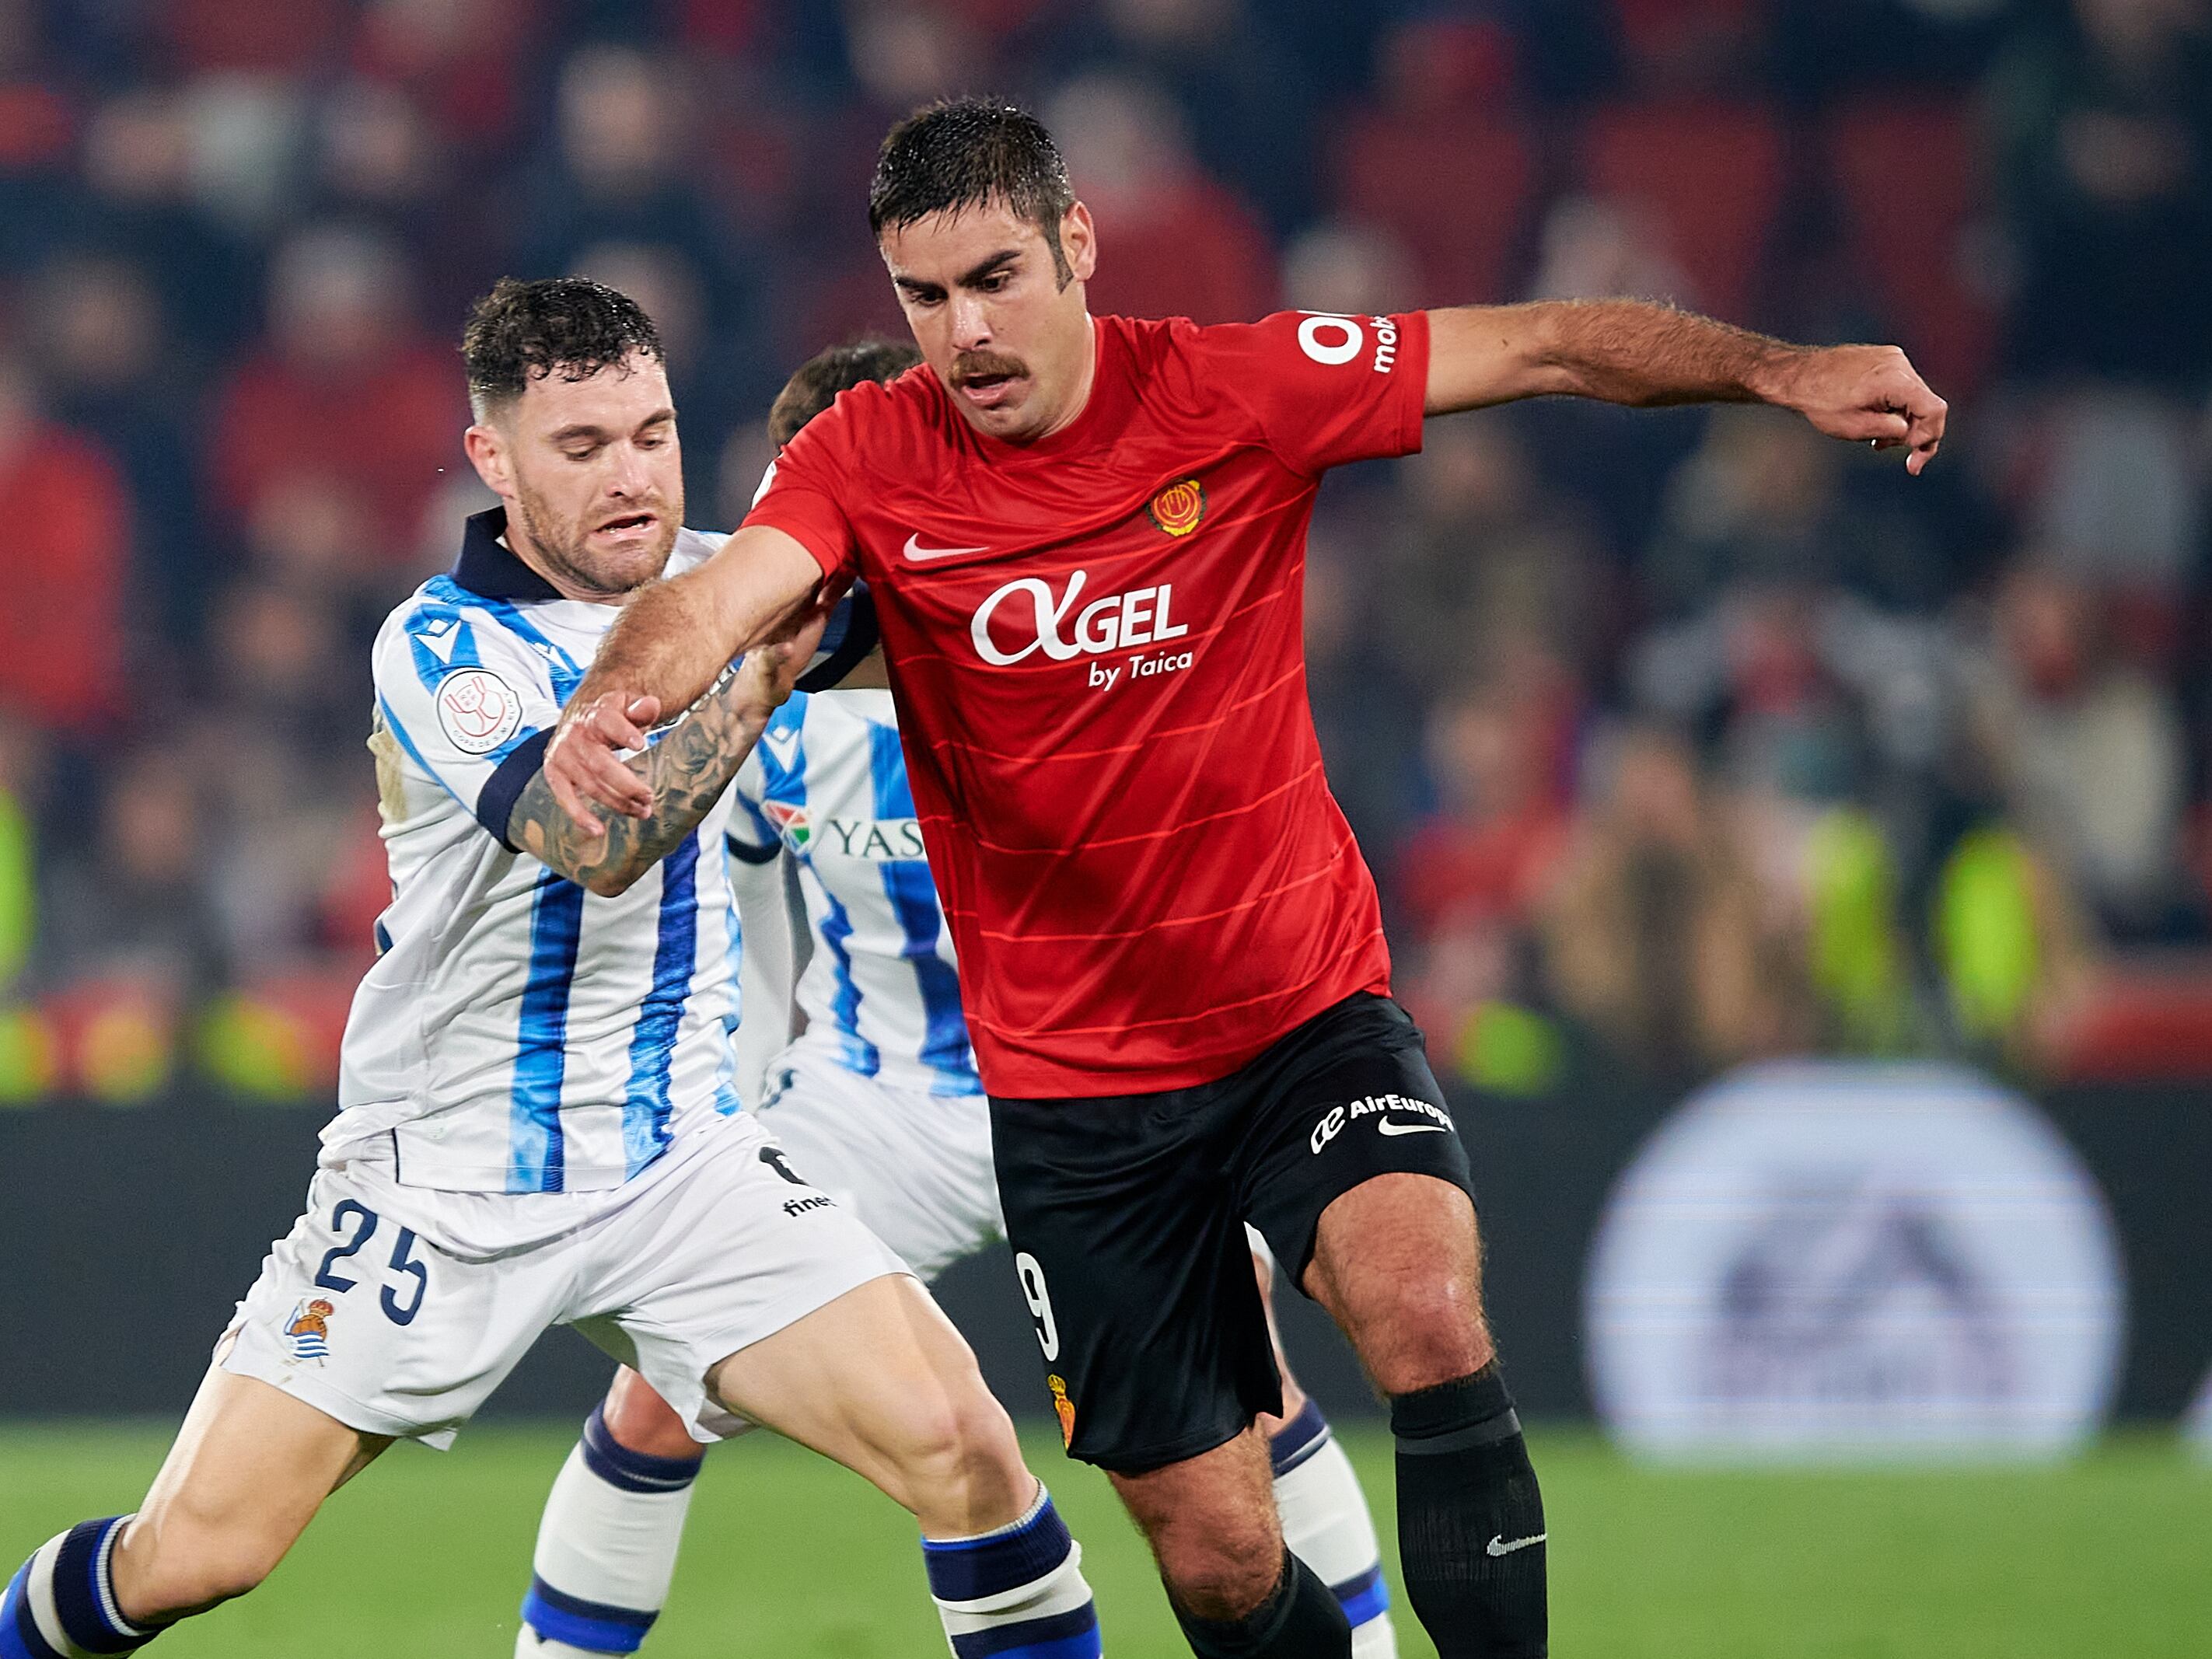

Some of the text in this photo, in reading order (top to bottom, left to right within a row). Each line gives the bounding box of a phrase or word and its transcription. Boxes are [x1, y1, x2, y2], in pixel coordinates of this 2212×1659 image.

[1089, 651, 1193, 692] by Taica
[830, 819, 924, 857] YAS
[314, 1198, 428, 1326] 25
[1015, 1252, 1060, 1362] 9
